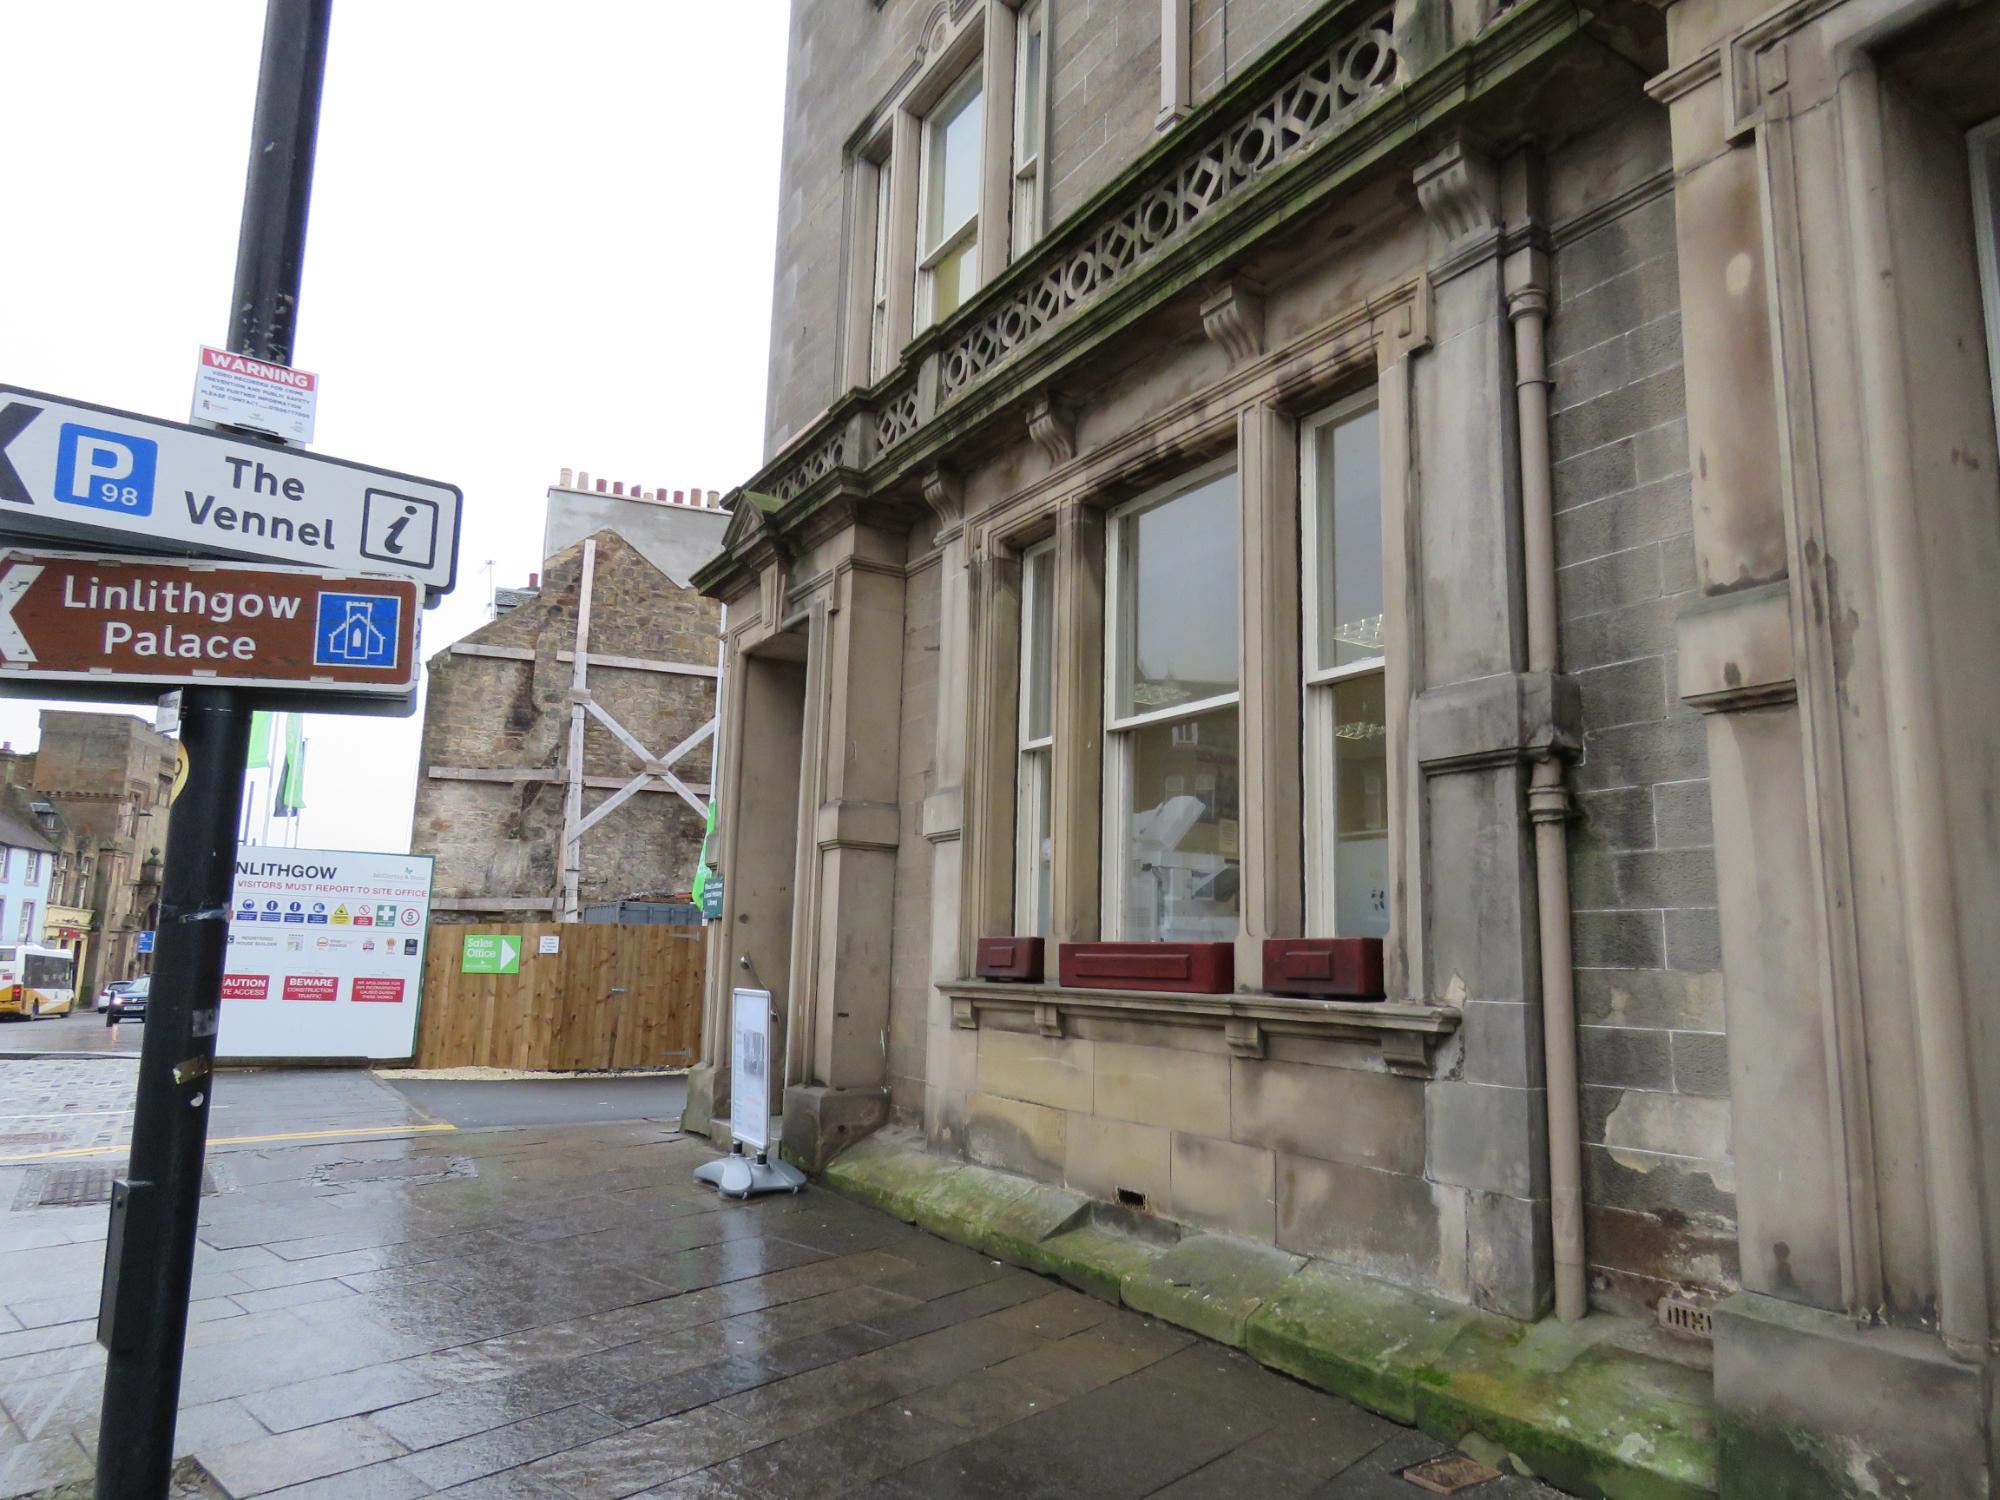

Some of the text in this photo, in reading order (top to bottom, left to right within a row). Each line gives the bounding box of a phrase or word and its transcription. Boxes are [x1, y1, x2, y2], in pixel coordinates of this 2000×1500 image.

[210, 352, 308, 387] WARNING
[201, 390, 225, 399] PLEASE
[203, 376, 245, 389] PREVENTION
[263, 389, 285, 398] PUBLIC
[286, 395, 310, 405] SAFETY
[211, 384, 224, 392] FOR
[258, 396, 302, 409] INFORMATION
[72, 434, 134, 498] P
[225, 456, 304, 501] The
[101, 483, 138, 506] 98
[184, 491, 335, 550] Vennel
[64, 575, 301, 623] Linlithgow
[104, 621, 256, 660] Palace
[238, 880, 427, 898] VISITORS MUST REPORT TO SITE OFFICE
[408, 911, 414, 919] 5
[466, 948, 497, 958] Office
[467, 938, 493, 948] Sales
[289, 977, 334, 987] BEWARE
